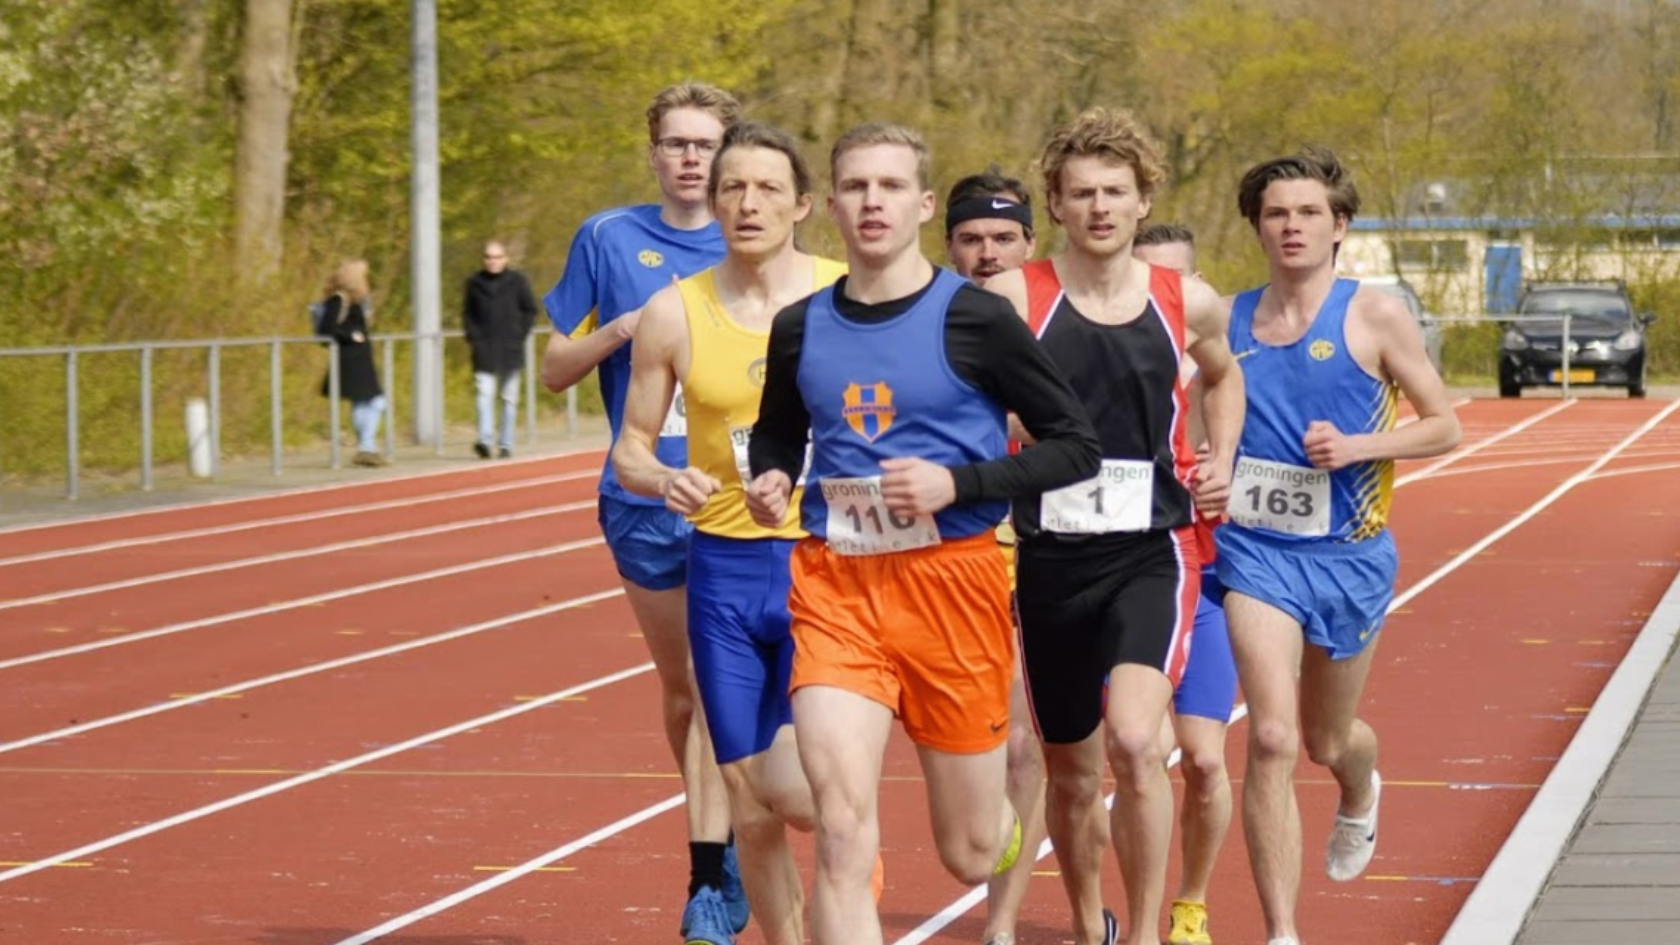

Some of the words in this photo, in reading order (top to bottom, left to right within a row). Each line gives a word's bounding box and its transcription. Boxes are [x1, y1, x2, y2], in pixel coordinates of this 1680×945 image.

[1236, 461, 1327, 487] groningen
[823, 480, 879, 500] gronin
[1087, 486, 1104, 514] 1
[1245, 485, 1314, 517] 163
